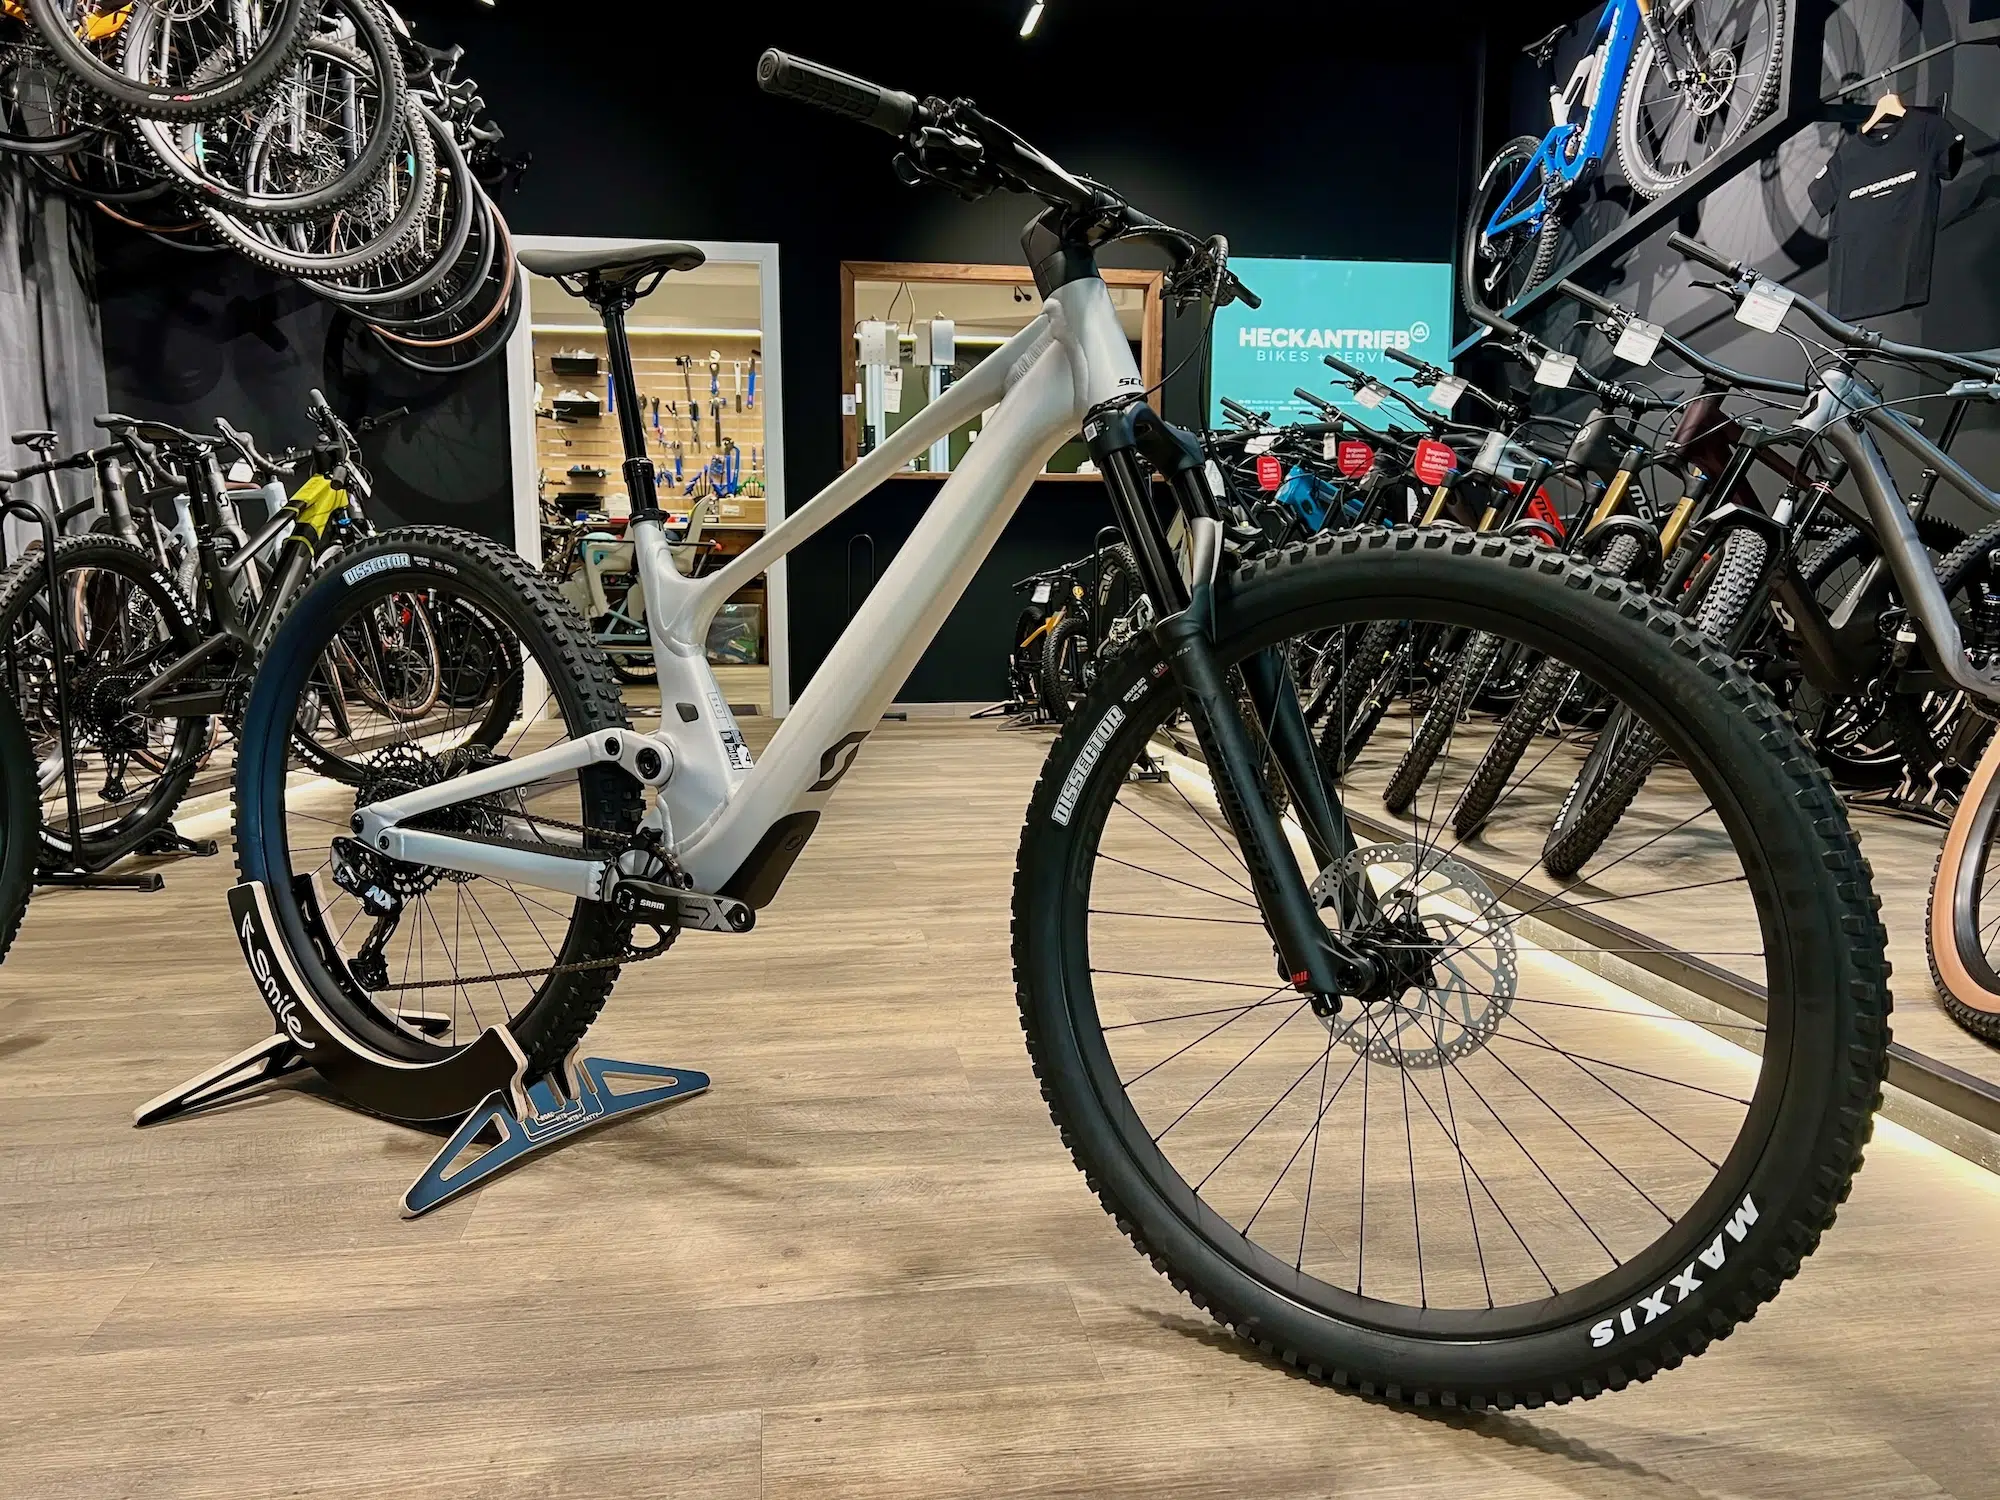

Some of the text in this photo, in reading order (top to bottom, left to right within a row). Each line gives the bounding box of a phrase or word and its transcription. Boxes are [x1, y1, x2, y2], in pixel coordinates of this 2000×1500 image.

[1239, 327, 1411, 349] HECKANTRIEB
[1256, 351, 1310, 362] BIKES
[341, 553, 411, 586] DISSECTOR
[150, 571, 193, 626] MAXXIS
[1051, 704, 1126, 826] DISSECTOR
[640, 899, 665, 911] SRAM
[250, 948, 316, 1050] Smile
